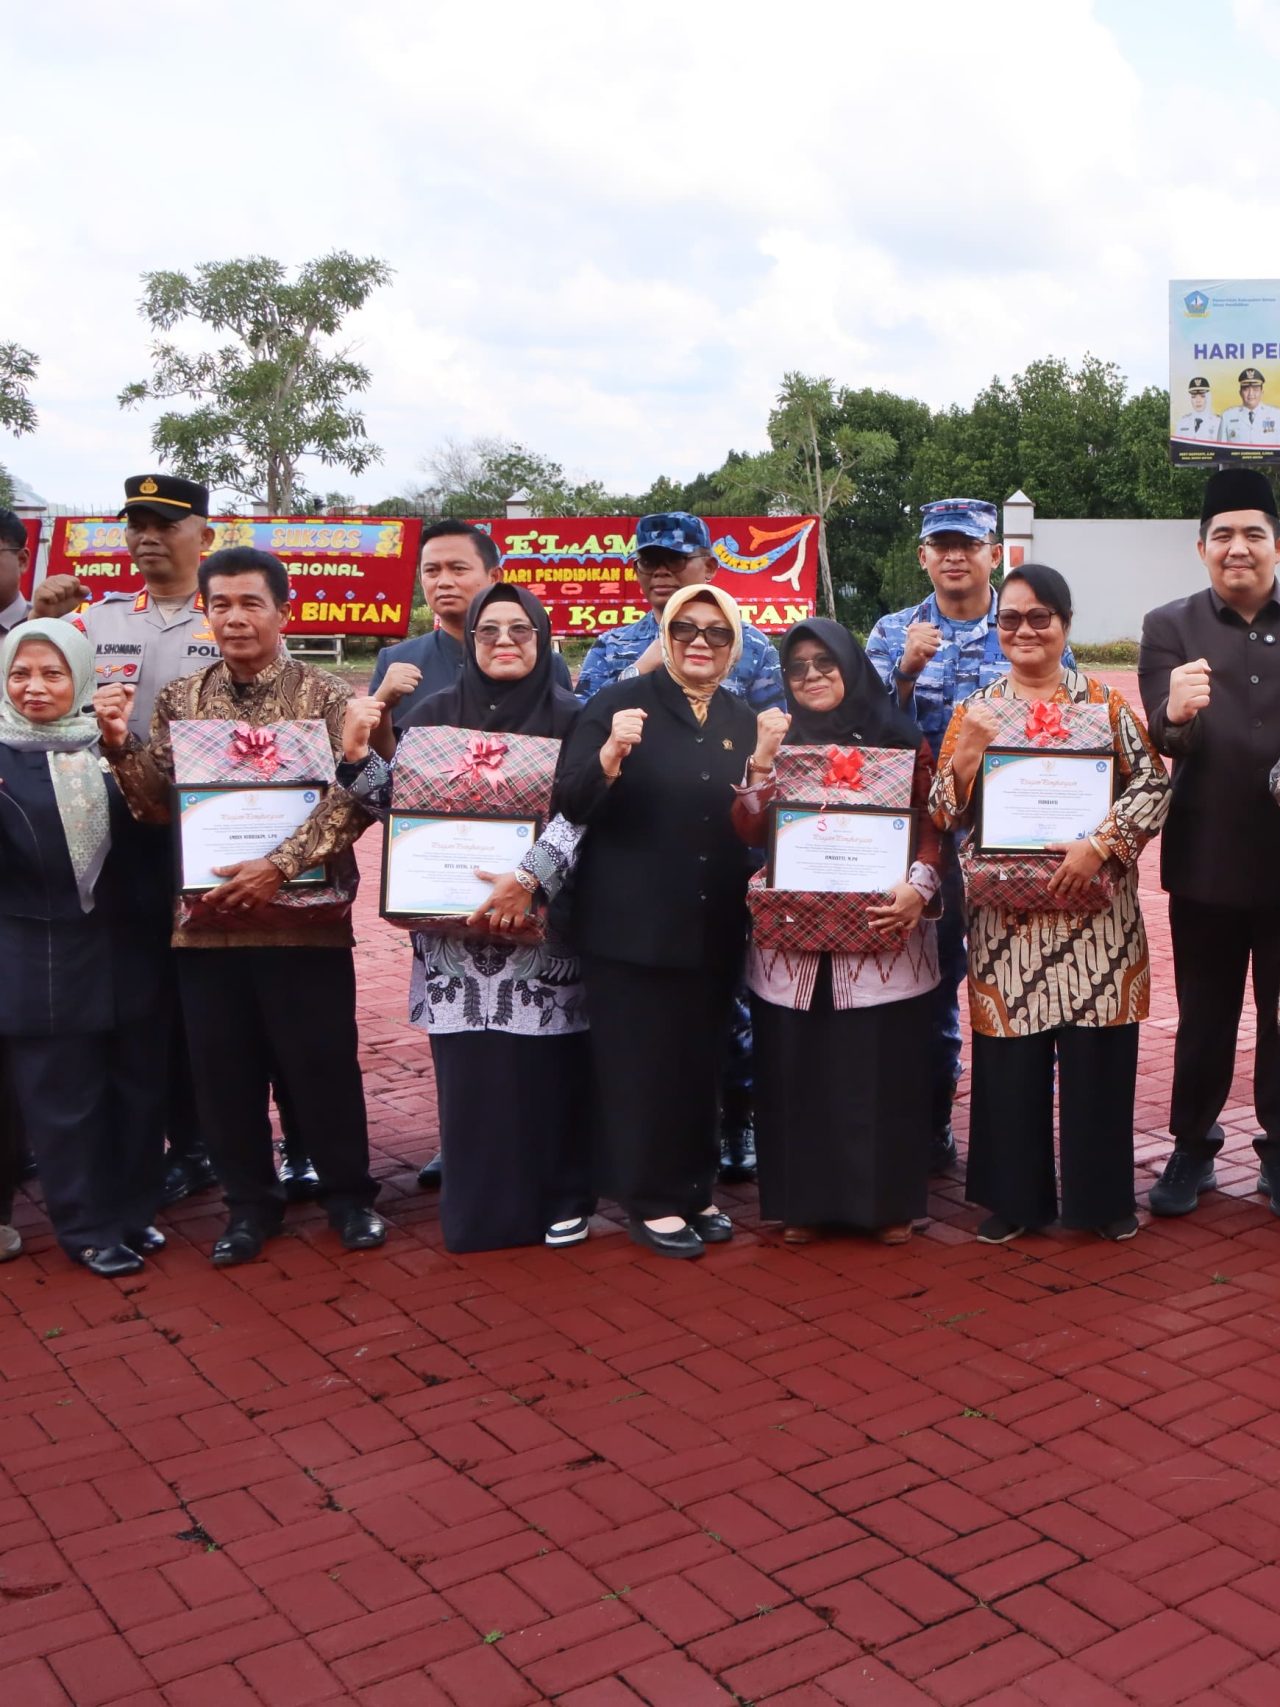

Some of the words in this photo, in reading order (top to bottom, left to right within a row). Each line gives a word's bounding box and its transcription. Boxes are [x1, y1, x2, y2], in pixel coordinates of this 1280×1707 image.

[1194, 343, 1245, 360] HARI
[74, 562, 121, 577] HARI
[301, 602, 402, 623] BINTAN
